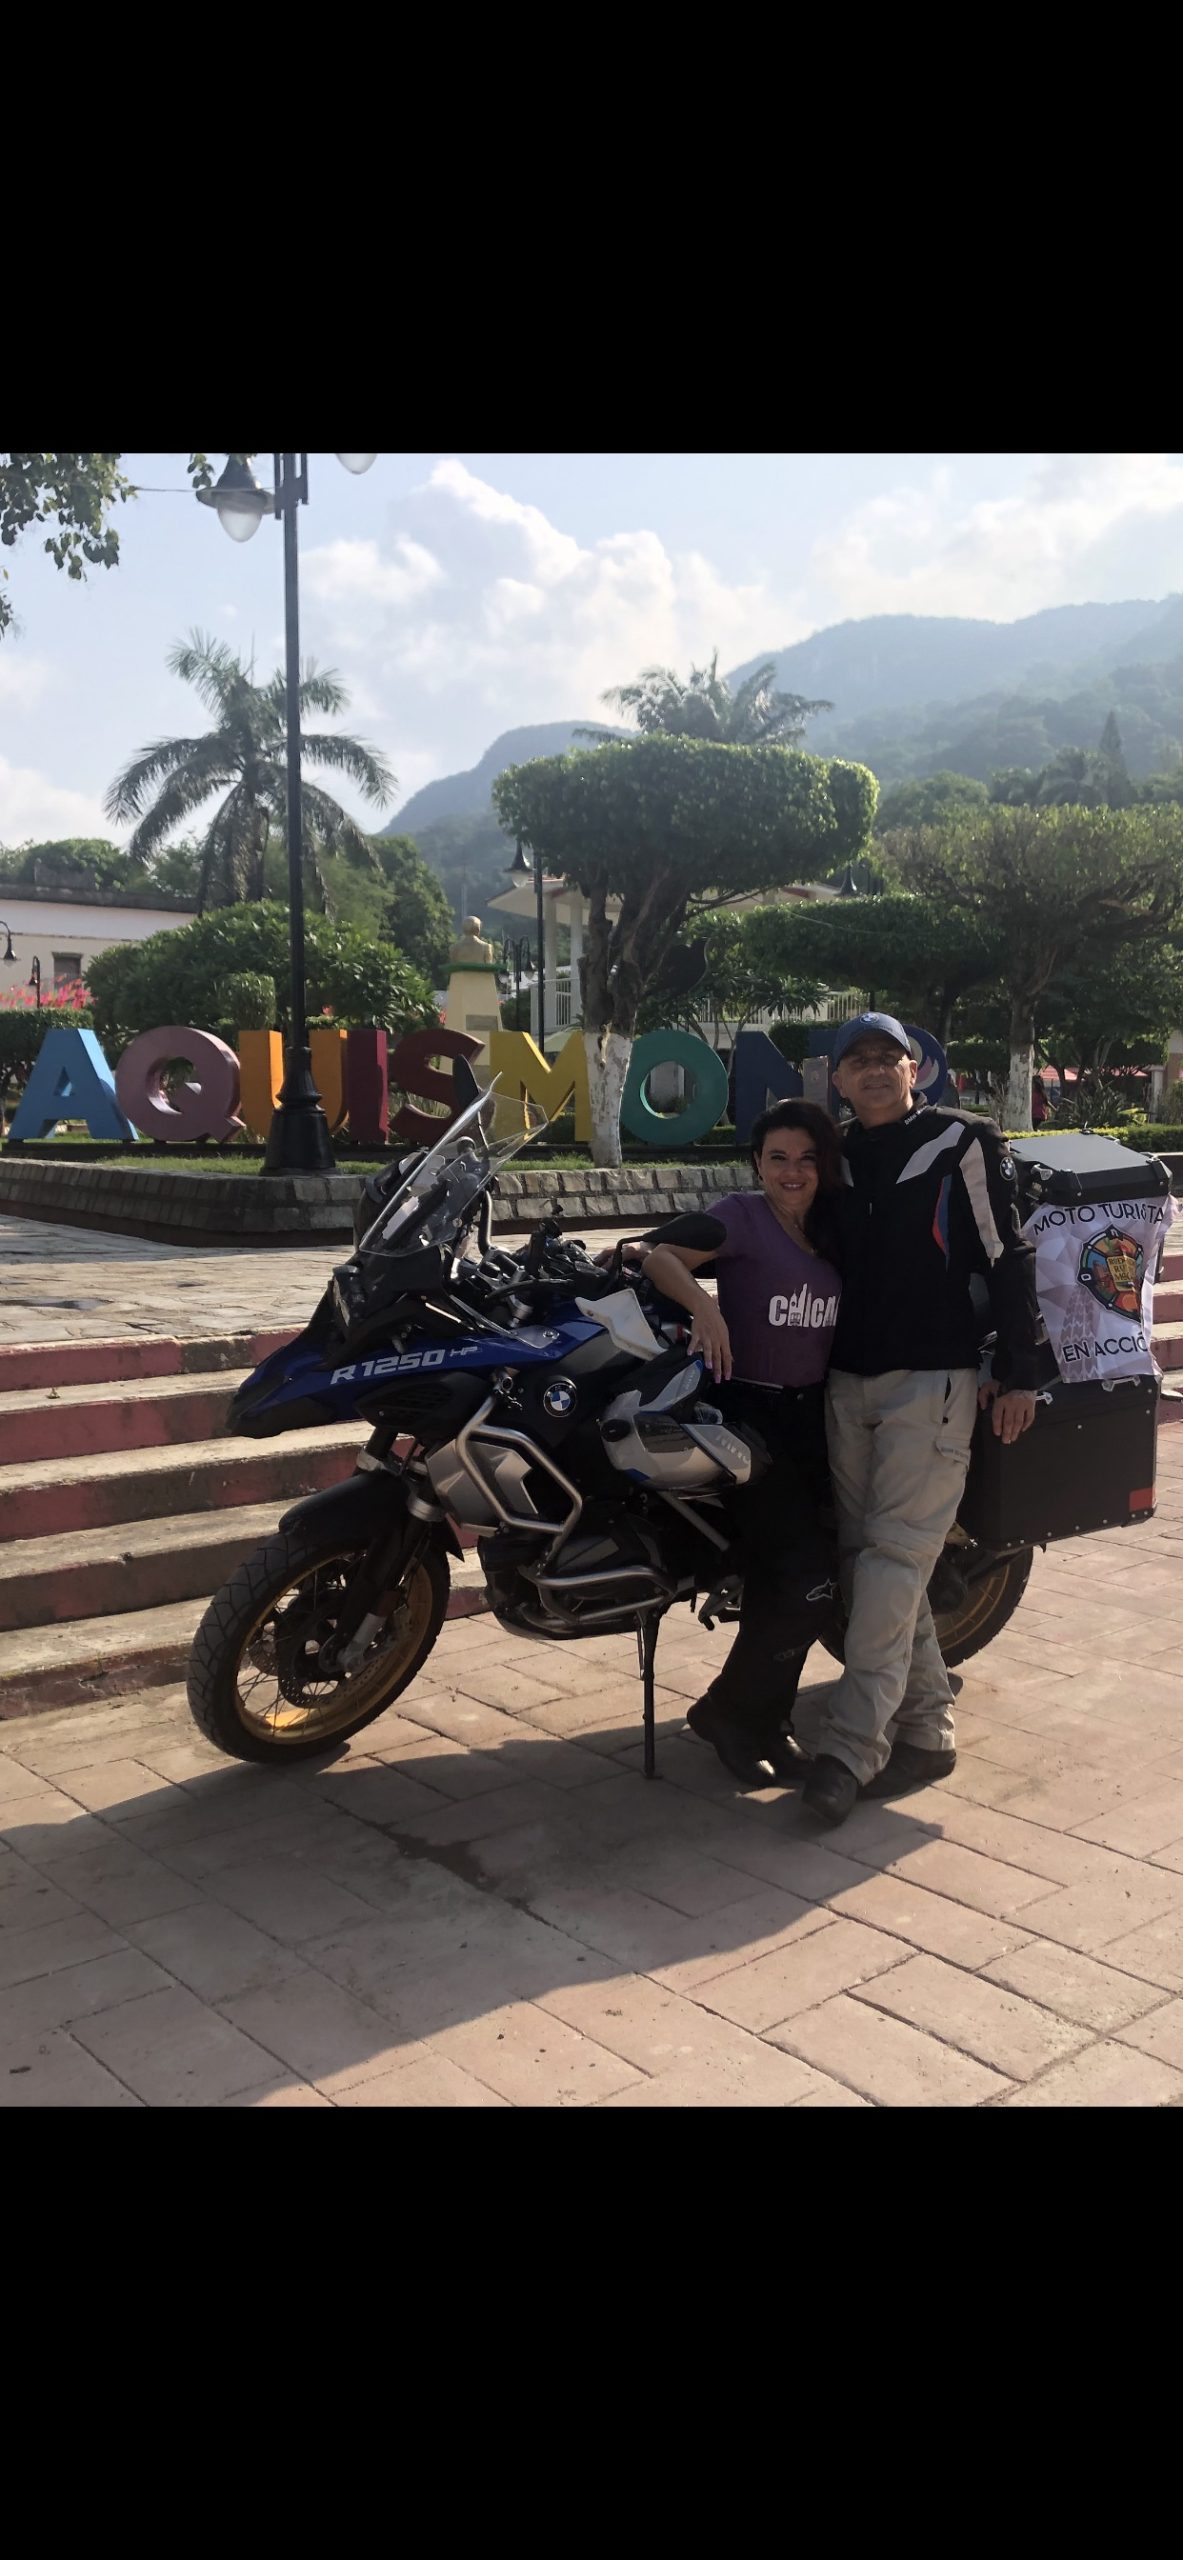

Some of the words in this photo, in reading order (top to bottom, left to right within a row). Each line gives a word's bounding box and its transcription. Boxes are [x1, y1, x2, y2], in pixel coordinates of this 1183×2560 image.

[1032, 1205, 1095, 1236] MOTO
[1098, 1203, 1164, 1224] TURISTA
[768, 1283, 841, 1328] CHICA
[330, 1365, 357, 1385] R
[361, 1349, 446, 1377] 1250
[450, 1346, 478, 1357] HP
[1062, 1341, 1090, 1362] EN
